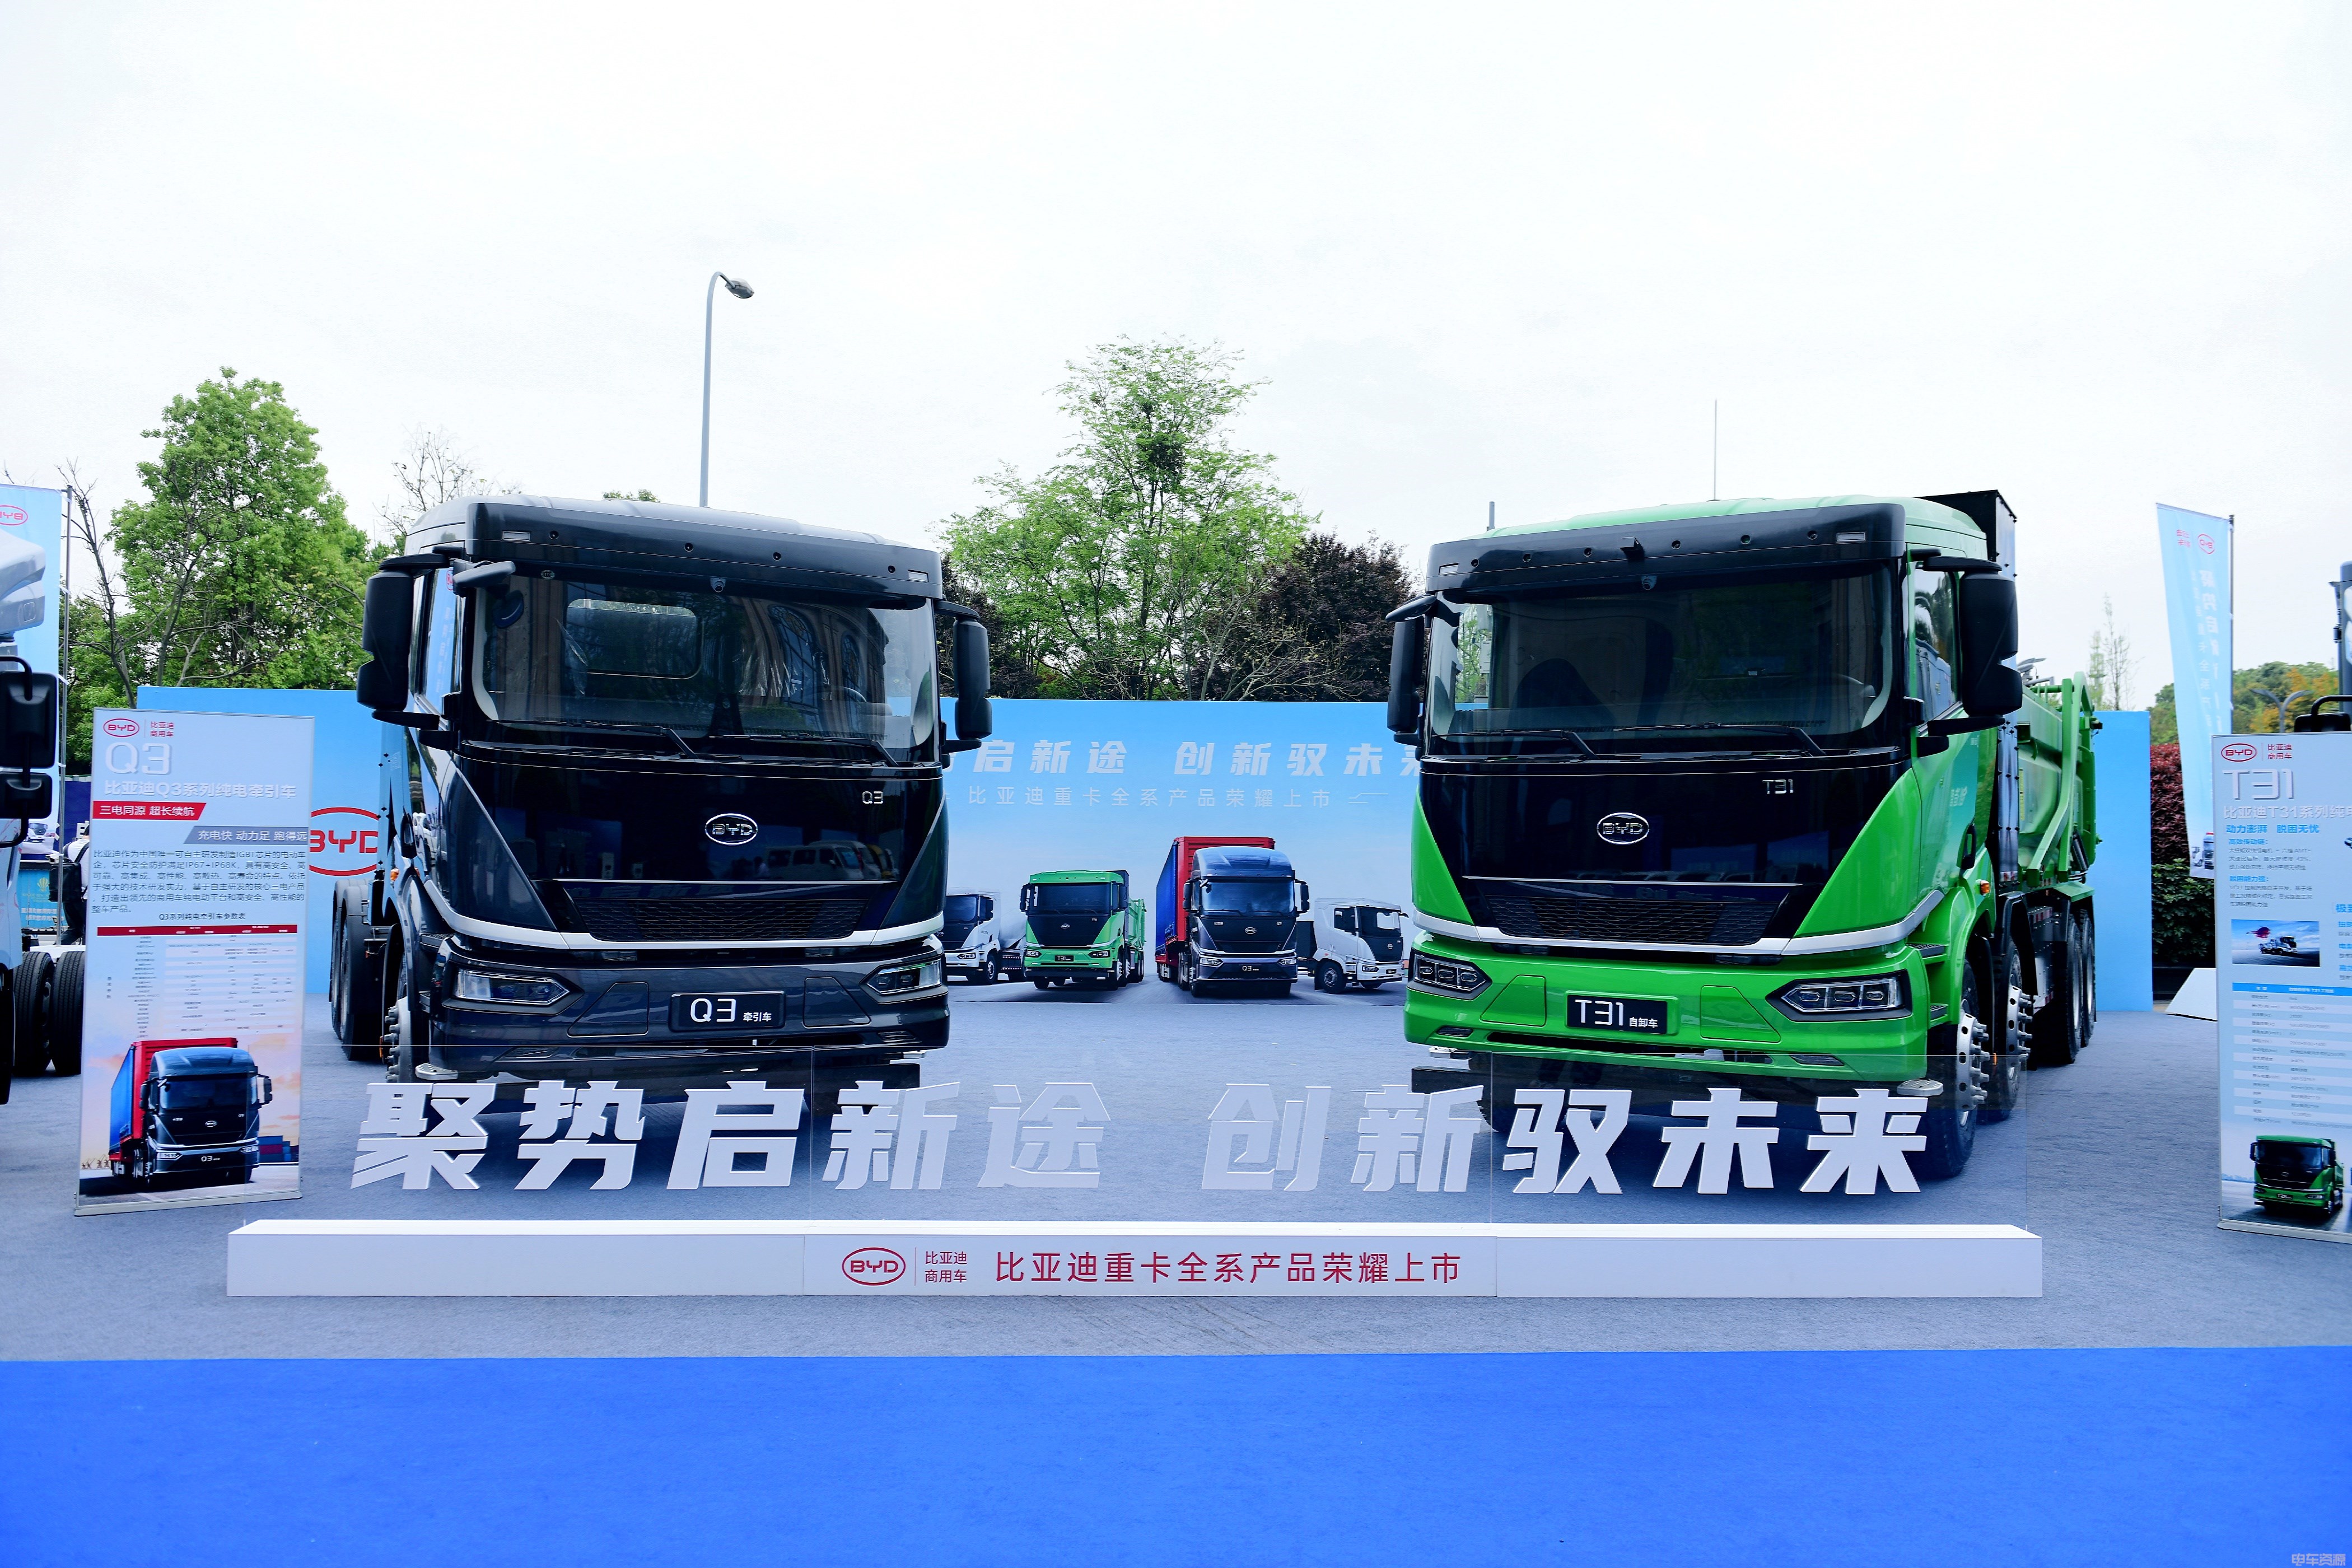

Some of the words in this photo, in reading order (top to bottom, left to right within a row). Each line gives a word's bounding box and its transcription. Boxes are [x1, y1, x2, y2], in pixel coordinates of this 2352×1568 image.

[2267, 743, 2293, 752] 比亚迪
[105, 742, 172, 775] Q3
[942, 740, 1128, 774] 启新途
[104, 780, 296, 799] 比亚迪Q3系列纯电牵引车
[1762, 779, 1794, 794] T31
[2223, 768, 2294, 800] T31
[862, 791, 884, 804] Q3
[969, 785, 1331, 808] 比亚迪重卡全系产品荣耀上市
[100, 805, 146, 816] 三电同源
[149, 806, 195, 816] 超长续航
[712, 823, 753, 836] BYD
[1602, 823, 1644, 835] BYD
[2226, 824, 2267, 833] 动力澎湃
[2276, 824, 2320, 833] 脱困无忧
[197, 830, 232, 841] 充电快
[236, 830, 270, 841] 动力足
[274, 831, 308, 842] 跑得远
[94, 850, 306, 858] 比亚迪作为中国唯一可自主研发制造IGBT芯片的电动车
[93, 872, 305, 880] 可靠、高集成、高性能、高散热、高寿命的特点。依托
[92, 883, 305, 891] 于强大的技术研发实力，基于自主研发的核心三电产品
[91, 905, 132, 913] 整车产品。
[690, 998, 736, 1023] Q3
[743, 1012, 772, 1022] 牵引车
[1574, 999, 1623, 1026] T31
[1629, 1016, 1659, 1028] 自卸车
[350, 1080, 1113, 1190] 聚势启新途
[1201, 1084, 1928, 1194] 创新驭未来
[925, 1250, 968, 1265] 比亚迪
[850, 1260, 898, 1273] BYD
[996, 1251, 1460, 1284] 比亚迪重卡全系产品荣耀上市
[925, 1268, 968, 1284] 商用车
